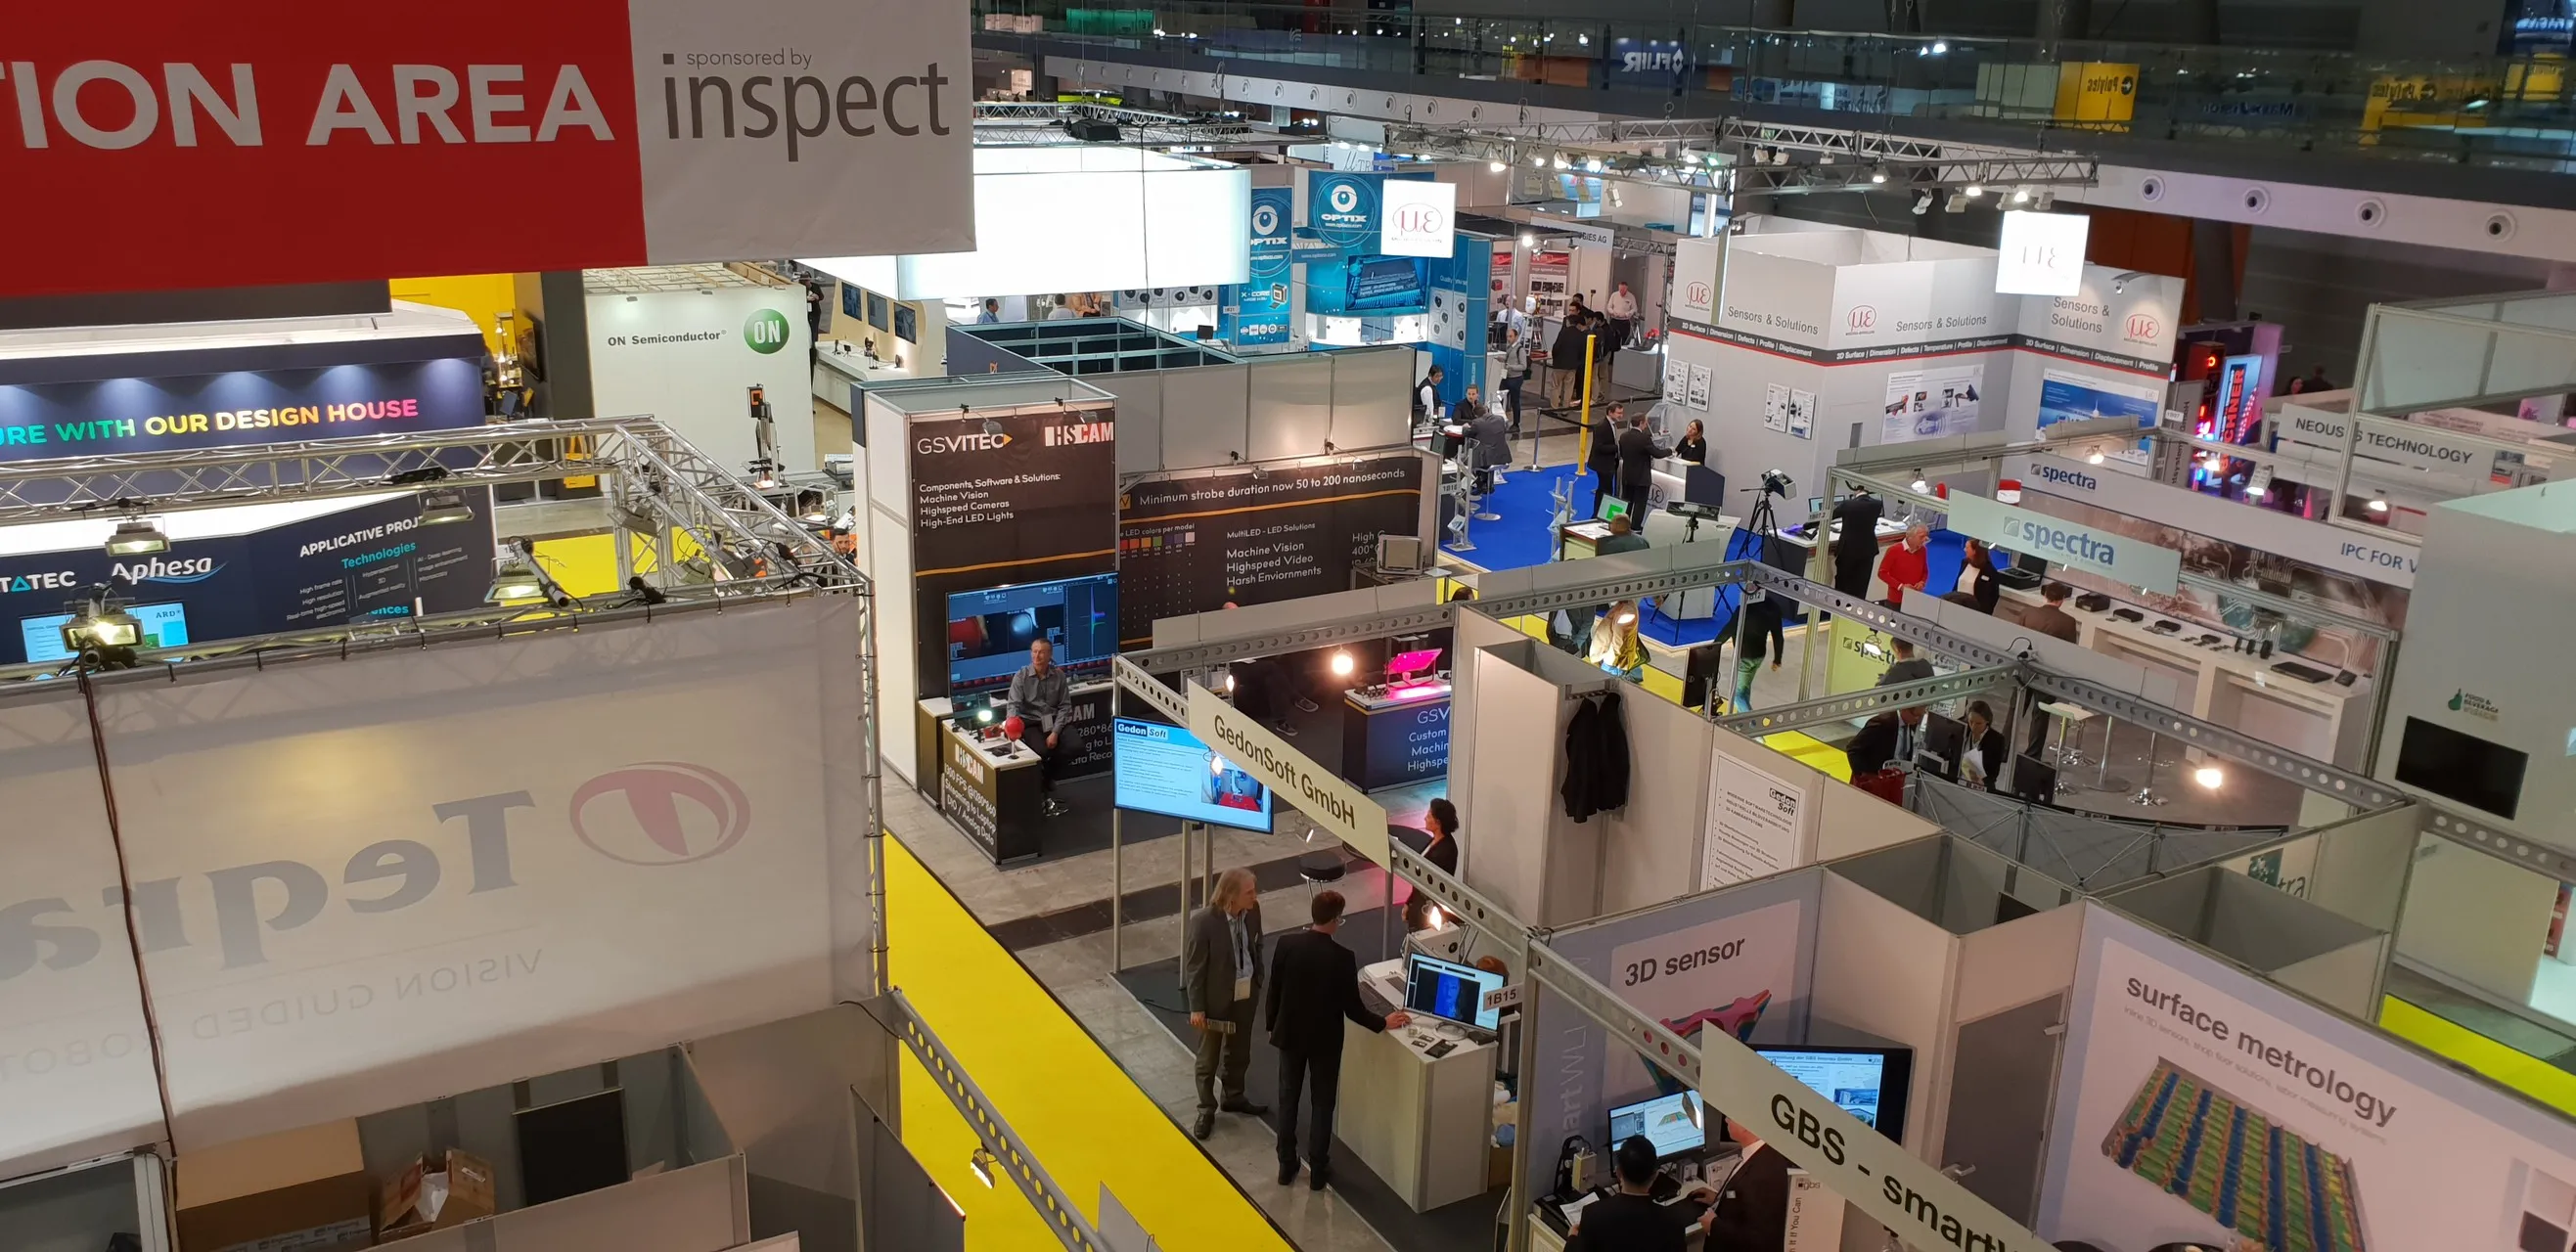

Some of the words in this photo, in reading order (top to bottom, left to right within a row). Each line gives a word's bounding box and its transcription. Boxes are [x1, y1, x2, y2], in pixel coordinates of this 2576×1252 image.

[686, 50, 785, 68] sponsored
[789, 48, 812, 69] by
[0, 60, 262, 150] ION
[305, 63, 615, 145] AREA
[662, 53, 950, 162] inspect
[1321, 213, 1368, 223] OPTIX
[1598, 234, 1607, 244] AG
[2054, 296, 2099, 315] Sensors
[2101, 304, 2110, 317] &
[1728, 306, 1763, 323] Sensors
[1766, 313, 1773, 326] &
[1776, 315, 1819, 335] Solutions
[1896, 319, 1933, 333] Sensors
[1937, 318, 1943, 329] &
[1946, 314, 1988, 328] Solutions
[2051, 313, 2102, 334] Solutions
[608, 335, 626, 346] ON
[753, 319, 781, 344] ON
[1709, 328, 1734, 340] Dimension
[1738, 334, 1755, 344] Defects
[1759, 338, 1775, 349] Profile
[1779, 342, 1813, 357] Displacement
[1870, 348, 1897, 357] Dimension
[1900, 345, 1920, 354] Defects
[1923, 343, 1954, 352] Temperature
[1957, 340, 1973, 349] Profile
[2034, 339, 2056, 352] Surface
[2059, 345, 2090, 359] Dimension
[2095, 352, 2135, 367] Displacement
[2139, 361, 2159, 372] Profile
[55, 418, 136, 442] WITH
[145, 414, 209, 435] OUR
[215, 405, 320, 431] DESIGN
[327, 399, 419, 423] HOUSE
[917, 432, 1005, 455] GSVITEC
[2294, 417, 2363, 442] NEOUSS
[2368, 431, 2473, 465] TECHNOLOGY
[919, 480, 974, 493] Components,
[974, 477, 1014, 488] Software
[1014, 474, 1020, 484] &
[1021, 472, 1062, 483] Solutions:
[1140, 492, 1189, 506] Minimum
[1191, 488, 1225, 501] strobe
[1227, 483, 1270, 498] duration
[1272, 481, 1294, 492] now
[1295, 478, 1309, 489] 50
[1310, 476, 1321, 487] to
[1323, 474, 1341, 486] 200
[1342, 469, 1405, 484] nanoseconds
[2042, 465, 2098, 491] spectra
[920, 493, 958, 505] Machine
[961, 491, 989, 500] Vision
[920, 503, 969, 517] Highspeed
[971, 500, 1010, 511] Cameras
[920, 514, 964, 530] High-End
[965, 513, 985, 523] LED
[986, 511, 1015, 523] Lights
[1125, 528, 1141, 537] LED
[1141, 526, 1162, 536] colors
[1162, 525, 1174, 535] per
[1174, 522, 1196, 531] model
[1227, 527, 1261, 539] MultiLED
[1267, 525, 1283, 535] LED
[1284, 521, 1316, 533] Solutions
[299, 525, 384, 558] APPLICATIVE
[386, 515, 422, 536] PROJ
[1352, 531, 1375, 544] High
[2022, 520, 2115, 566] spectra
[341, 541, 417, 569] Technologies
[1227, 547, 1271, 559] Machine
[1273, 542, 1305, 553] Vision
[2340, 542, 2368, 560] IPC
[2370, 550, 2404, 570] FOR
[111, 556, 212, 586] Aphesa
[1227, 559, 1281, 575] Highspeed
[1284, 555, 1314, 565] Video
[1227, 575, 1256, 587] Harsh
[1258, 565, 1322, 583] Enviornments
[1117, 723, 1147, 736] Gedon
[1148, 727, 1167, 738] Soft
[1408, 729, 1447, 742] Custom
[1411, 740, 1449, 757] Machin
[1213, 714, 1298, 791] GedonSoft
[1300, 774, 1357, 831] GmbH
[1407, 756, 1448, 772] Highspe
[955, 772, 968, 792] FPS
[945, 777, 971, 812] Streaming
[971, 803, 976, 815] to
[976, 808, 997, 834] Laptop
[1771, 788, 1796, 809] Gedon
[1777, 802, 1795, 817] Soft
[962, 809, 981, 835] Analog
[980, 826, 995, 846] Data
[1625, 959, 1658, 987] 3D
[1664, 935, 1746, 977] sensor
[1486, 988, 1516, 1006] 1B15
[2126, 977, 2230, 1041] surface
[2237, 1031, 2398, 1128] metrology
[1771, 1094, 1845, 1166] GBS
[1882, 1175, 2018, 1252] smart
[1792, 1197, 1802, 1216] Can
[1790, 1216, 1800, 1231] You
